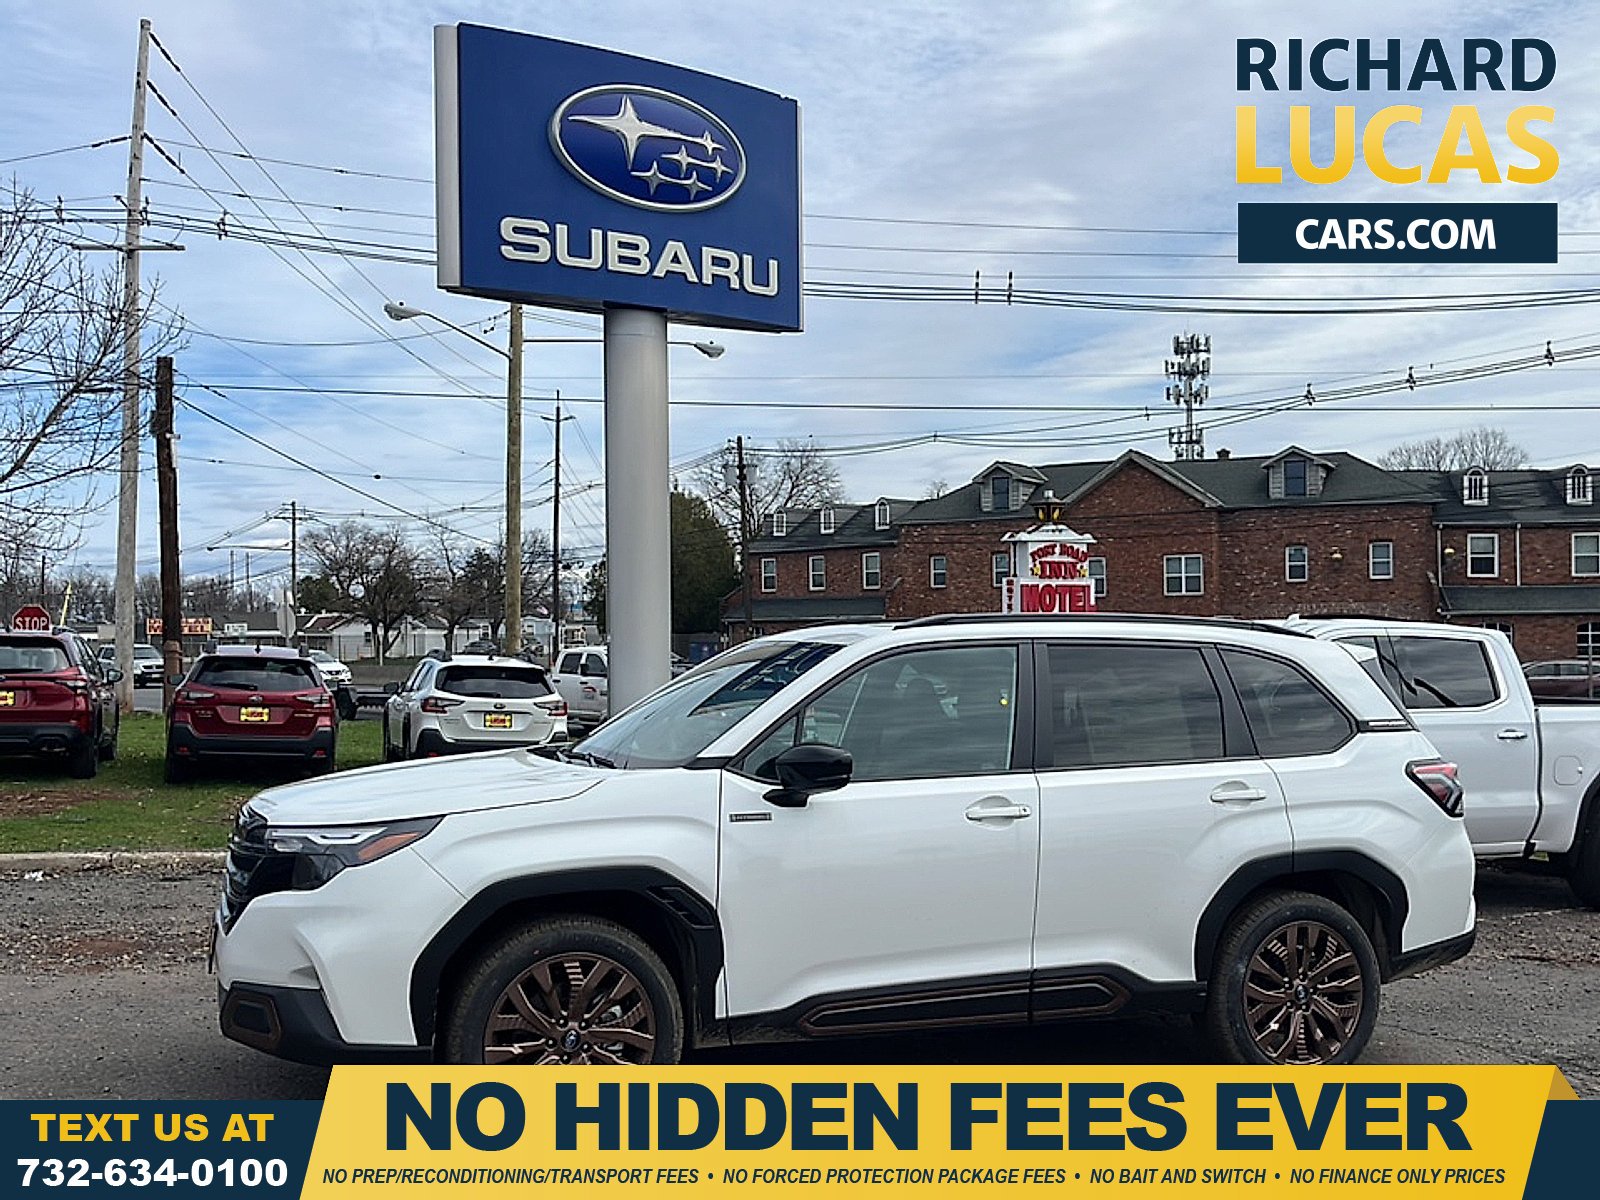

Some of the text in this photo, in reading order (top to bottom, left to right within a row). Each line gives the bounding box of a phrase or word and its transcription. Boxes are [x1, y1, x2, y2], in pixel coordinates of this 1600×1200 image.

[499, 216, 779, 297] SUBARU
[1039, 561, 1078, 579] INN
[1020, 584, 1098, 612] MOTEL
[15, 616, 48, 631] STOP
